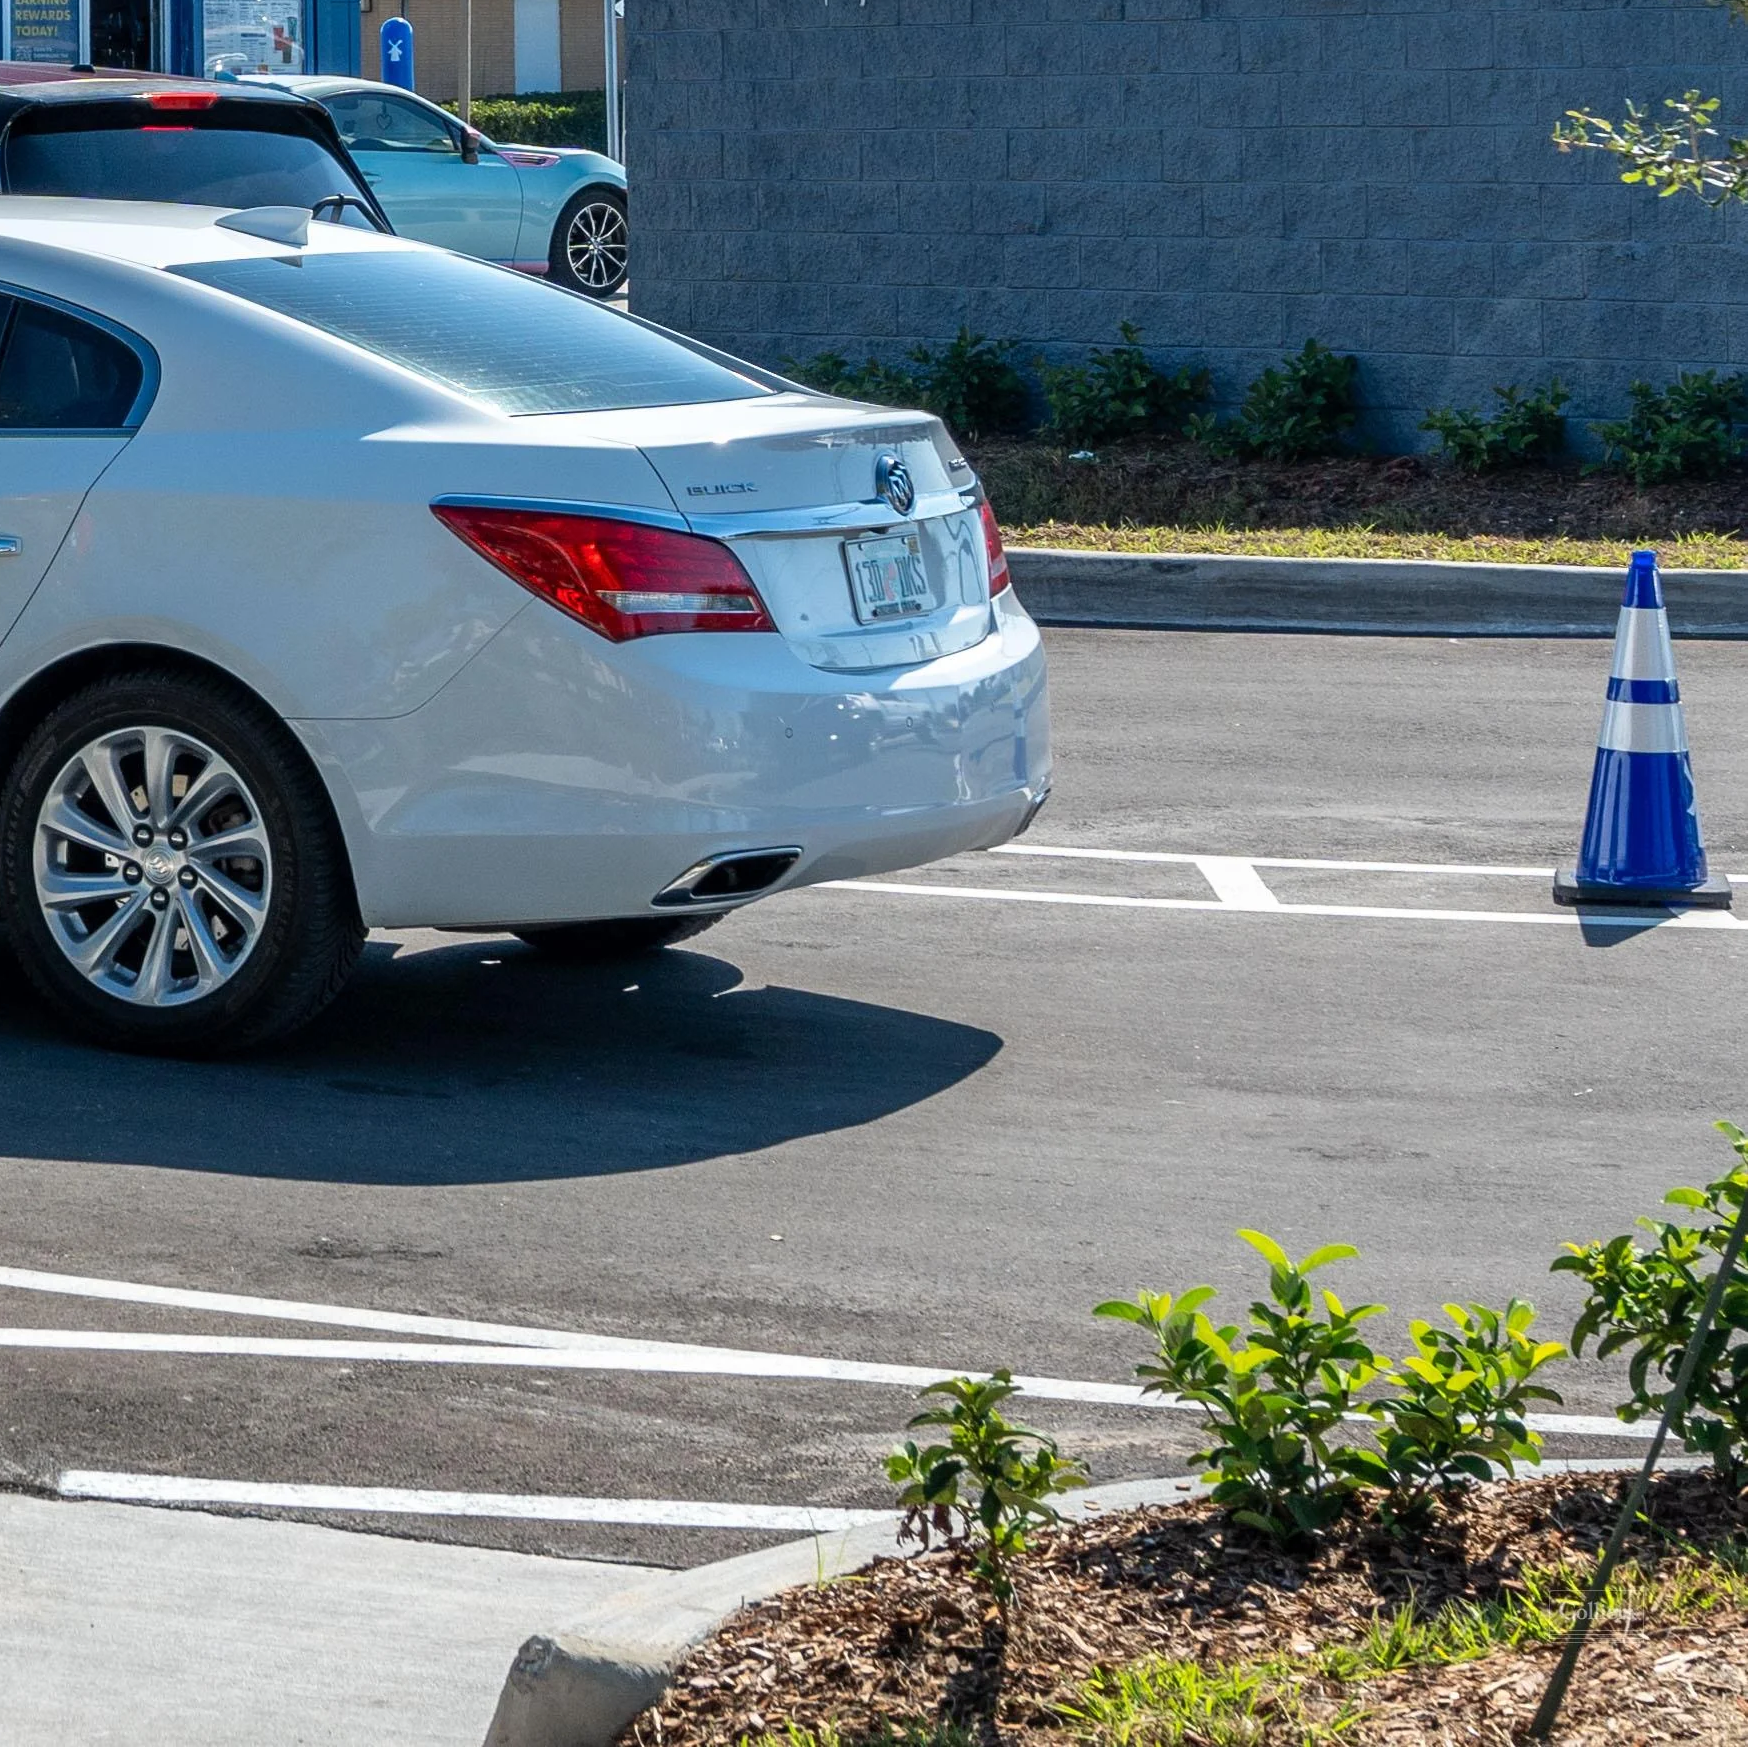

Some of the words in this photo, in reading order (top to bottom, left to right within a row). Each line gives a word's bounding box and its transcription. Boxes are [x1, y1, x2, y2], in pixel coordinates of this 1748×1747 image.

[15, 10, 71, 21] REWARDS
[16, 25, 58, 37] TODAY!
[686, 482, 759, 497] BUICK
